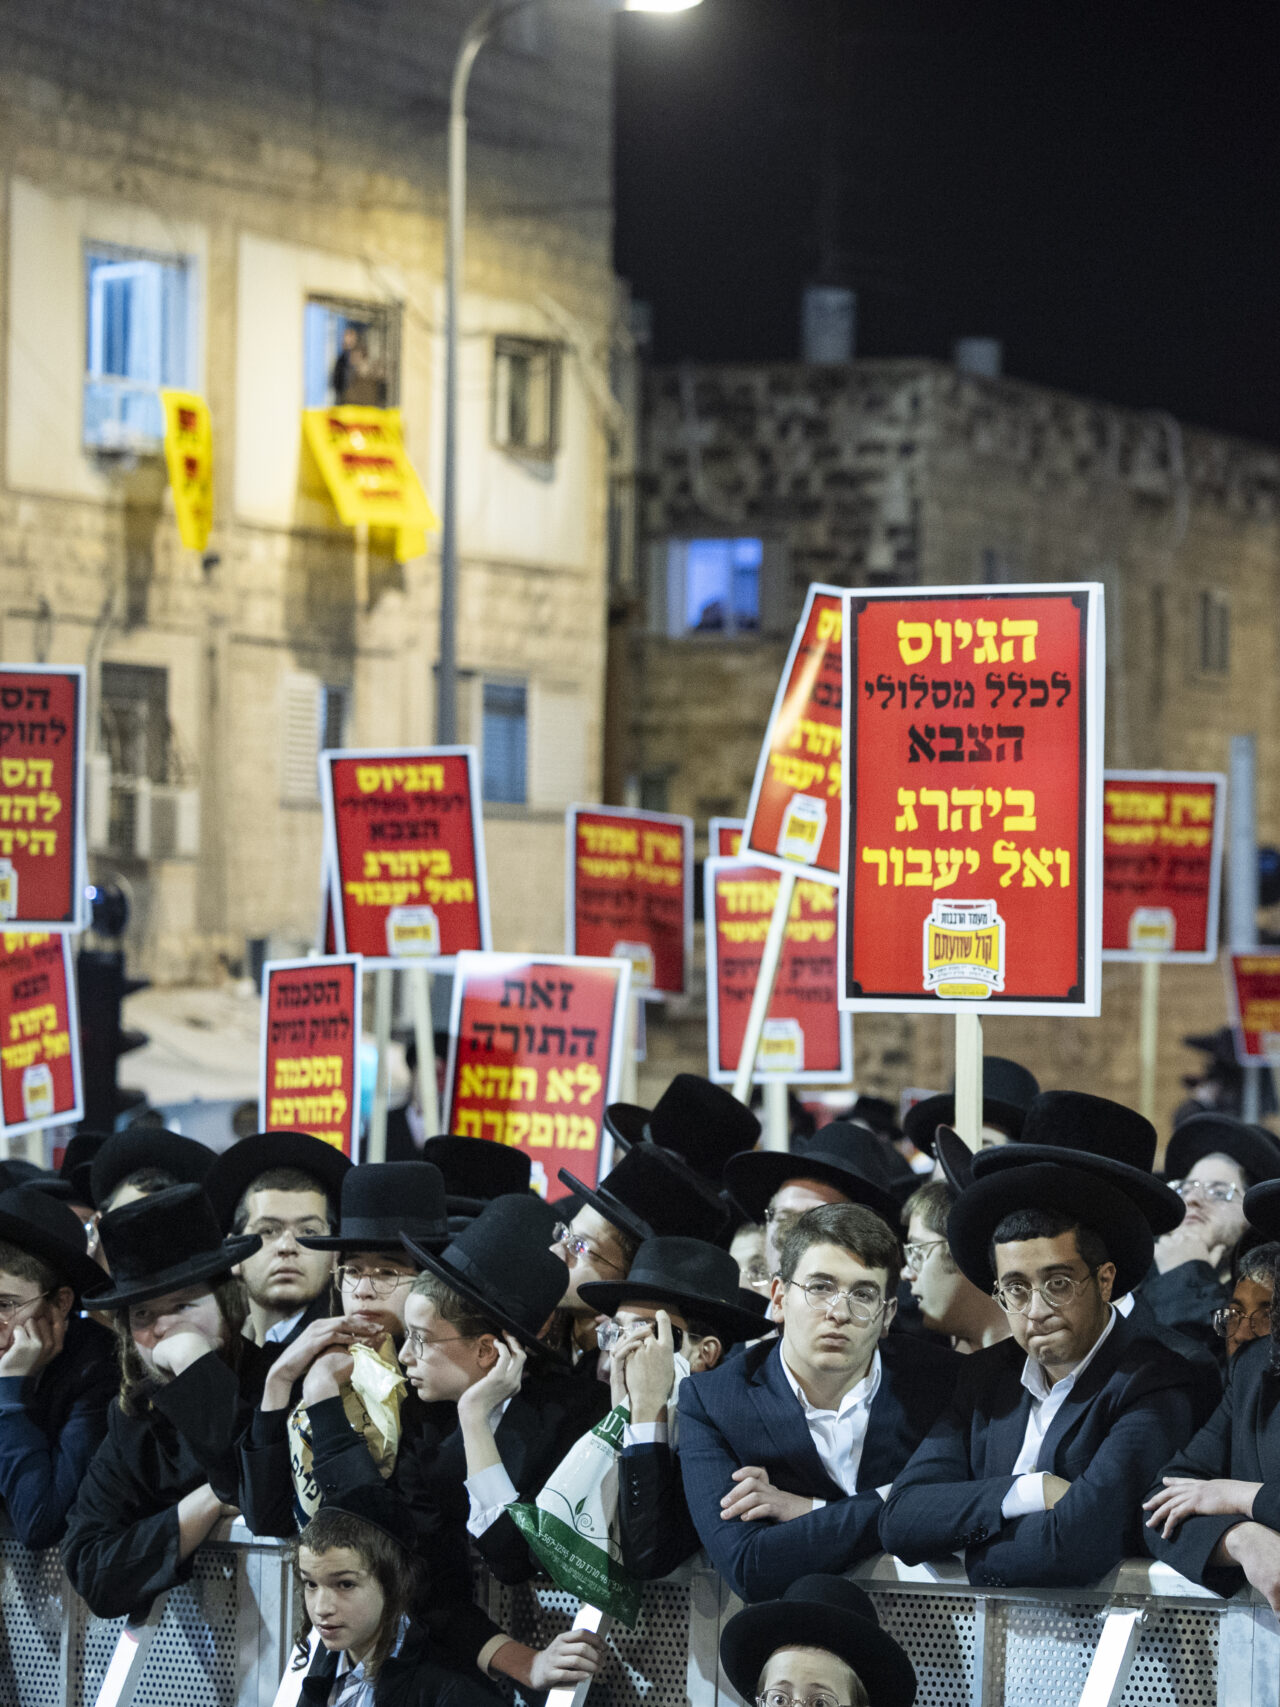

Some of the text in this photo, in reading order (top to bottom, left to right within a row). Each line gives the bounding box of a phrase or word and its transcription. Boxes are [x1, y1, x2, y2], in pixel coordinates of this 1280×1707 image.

[897, 618, 1039, 665] הגיוס
[864, 674, 975, 709] מסלולי
[985, 672, 1072, 708] לכלל
[908, 724, 1025, 763] הצבא
[356, 764, 445, 793] הגיוס
[895, 787, 1037, 833] ביהרג
[363, 849, 453, 878] ביהרג
[862, 846, 981, 891] יעבור
[993, 839, 1071, 888] ואל
[975, 931, 993, 965] קול
[500, 979, 574, 1012] זאת
[469, 1021, 598, 1057] התורה
[275, 1056, 343, 1090] הסכמה
[460, 1062, 602, 1105] לא תהא
